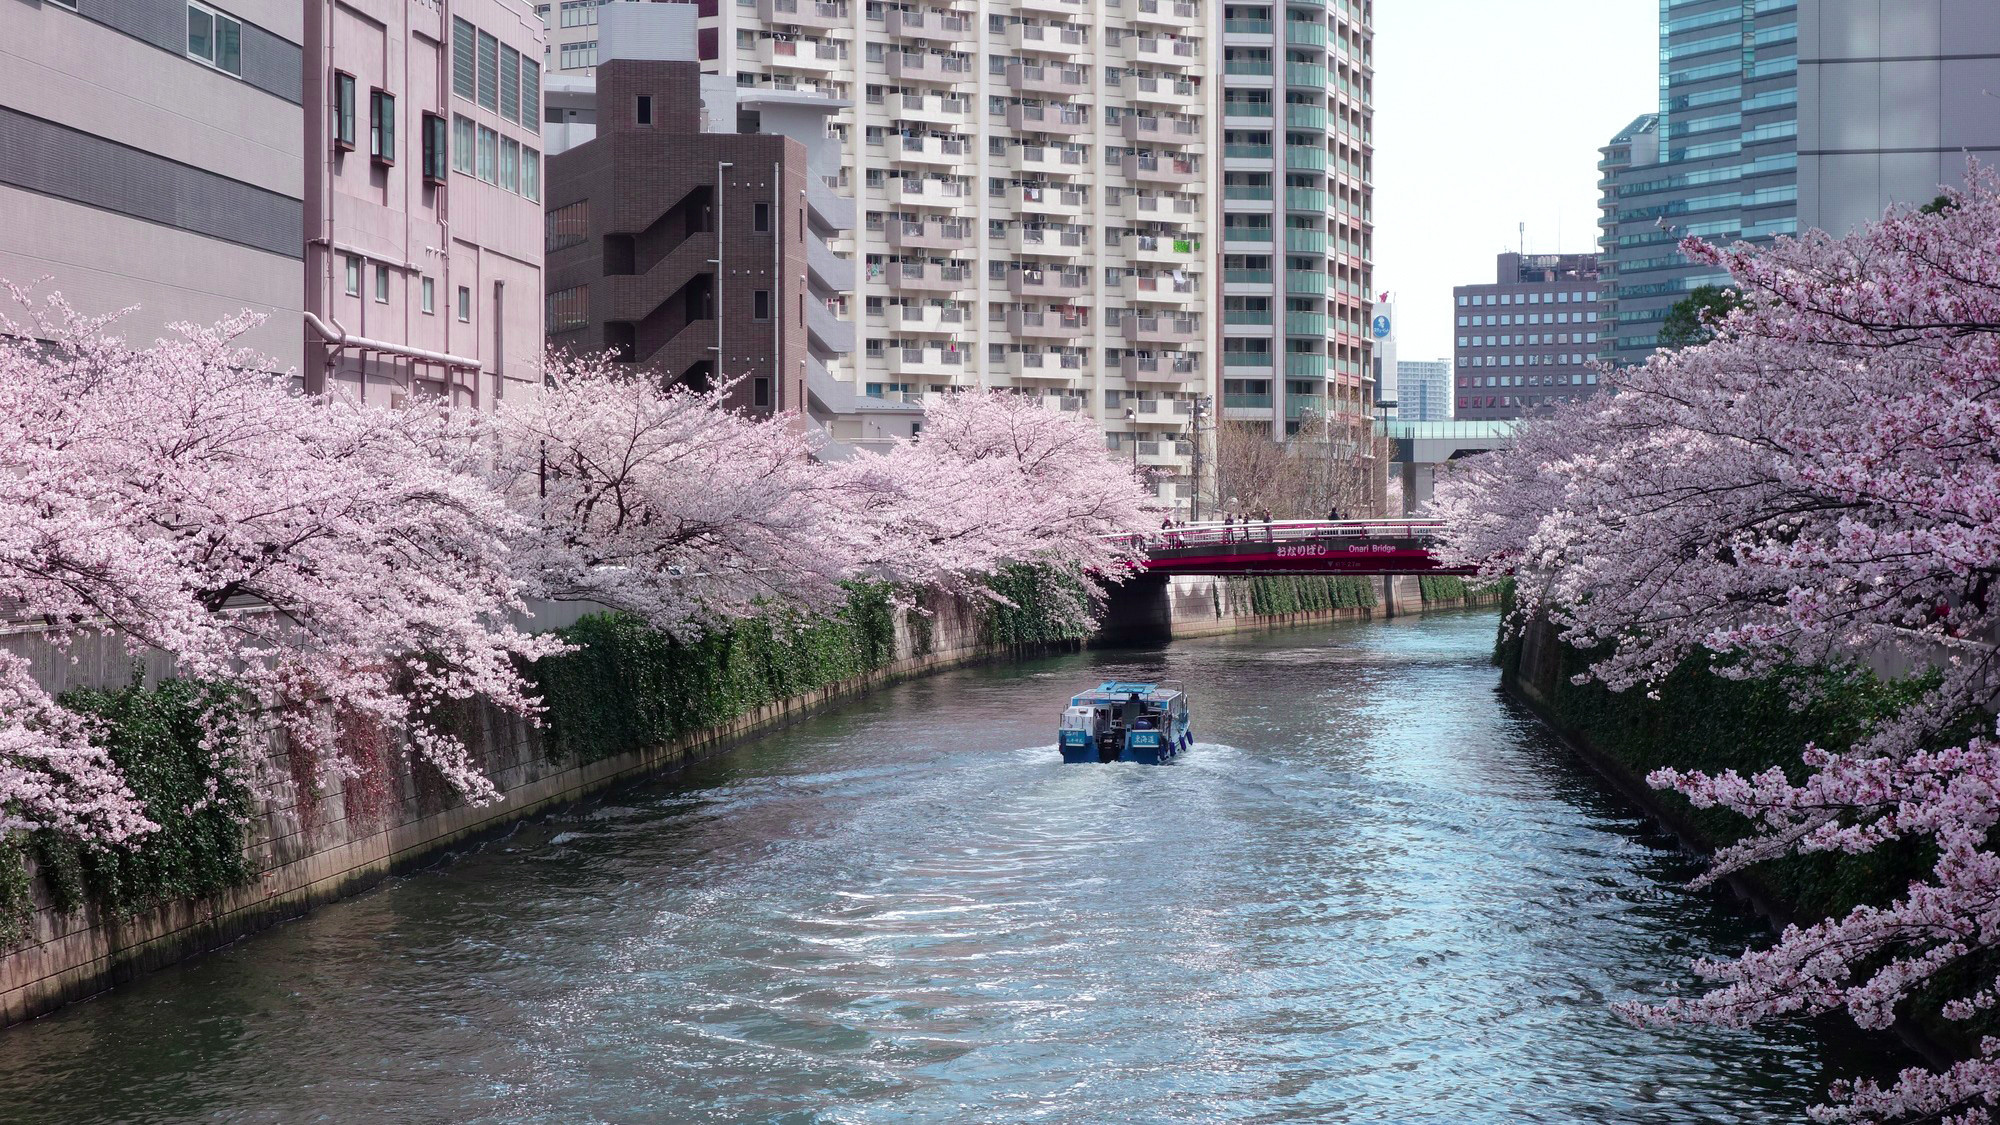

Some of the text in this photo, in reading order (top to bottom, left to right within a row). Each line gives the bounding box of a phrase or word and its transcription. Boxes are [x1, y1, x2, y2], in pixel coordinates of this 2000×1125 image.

[1276, 544, 1326, 557] おなりばし
[1348, 544, 1396, 554] Onari Bridge
